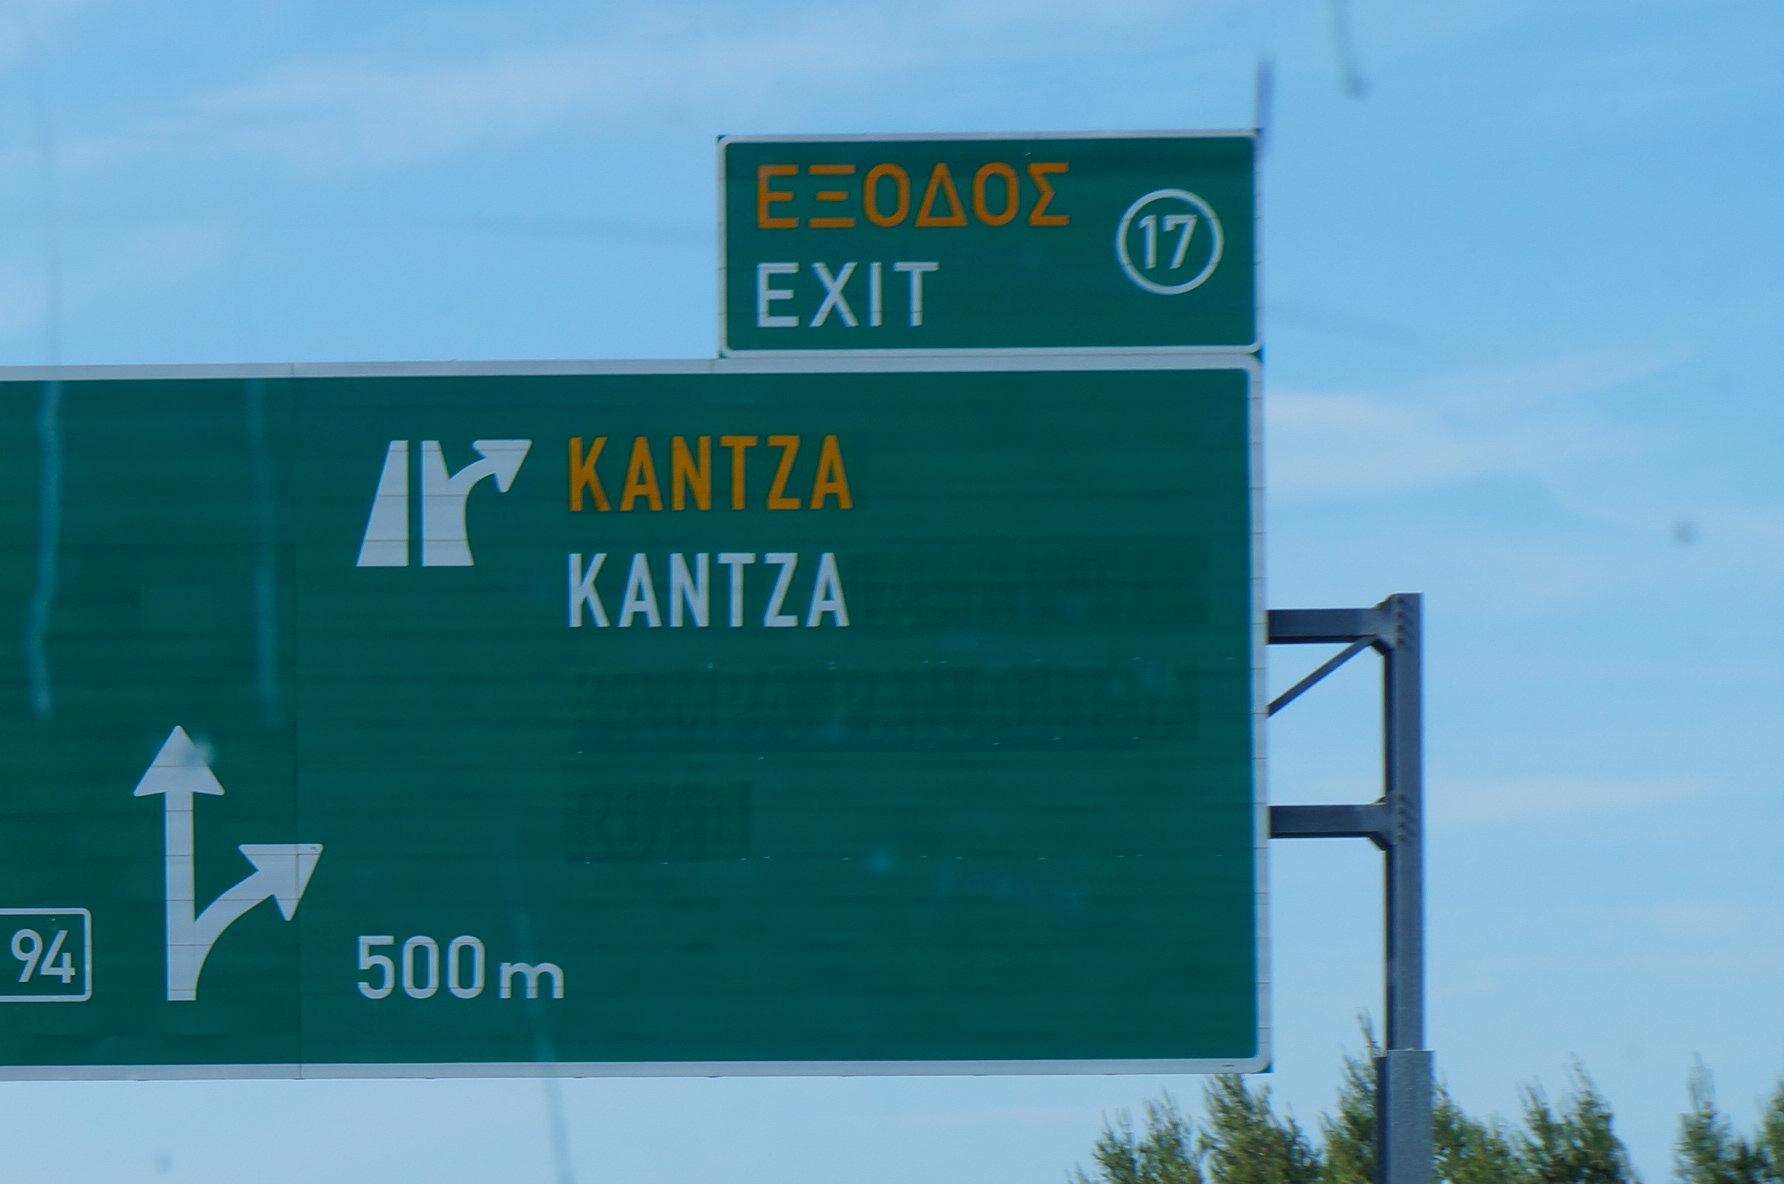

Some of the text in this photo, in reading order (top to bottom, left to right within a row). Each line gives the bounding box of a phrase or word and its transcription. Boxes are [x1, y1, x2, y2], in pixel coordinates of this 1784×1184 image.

[756, 161, 1070, 229] ΕΞΟΔΟΣ
[1138, 213, 1198, 270] 17
[756, 260, 941, 329] EXIT
[568, 434, 854, 512] ΚΑΝΤΖΑ
[568, 551, 851, 628] KANTZA
[10, 928, 77, 984] 94
[357, 934, 565, 1000] 500m
